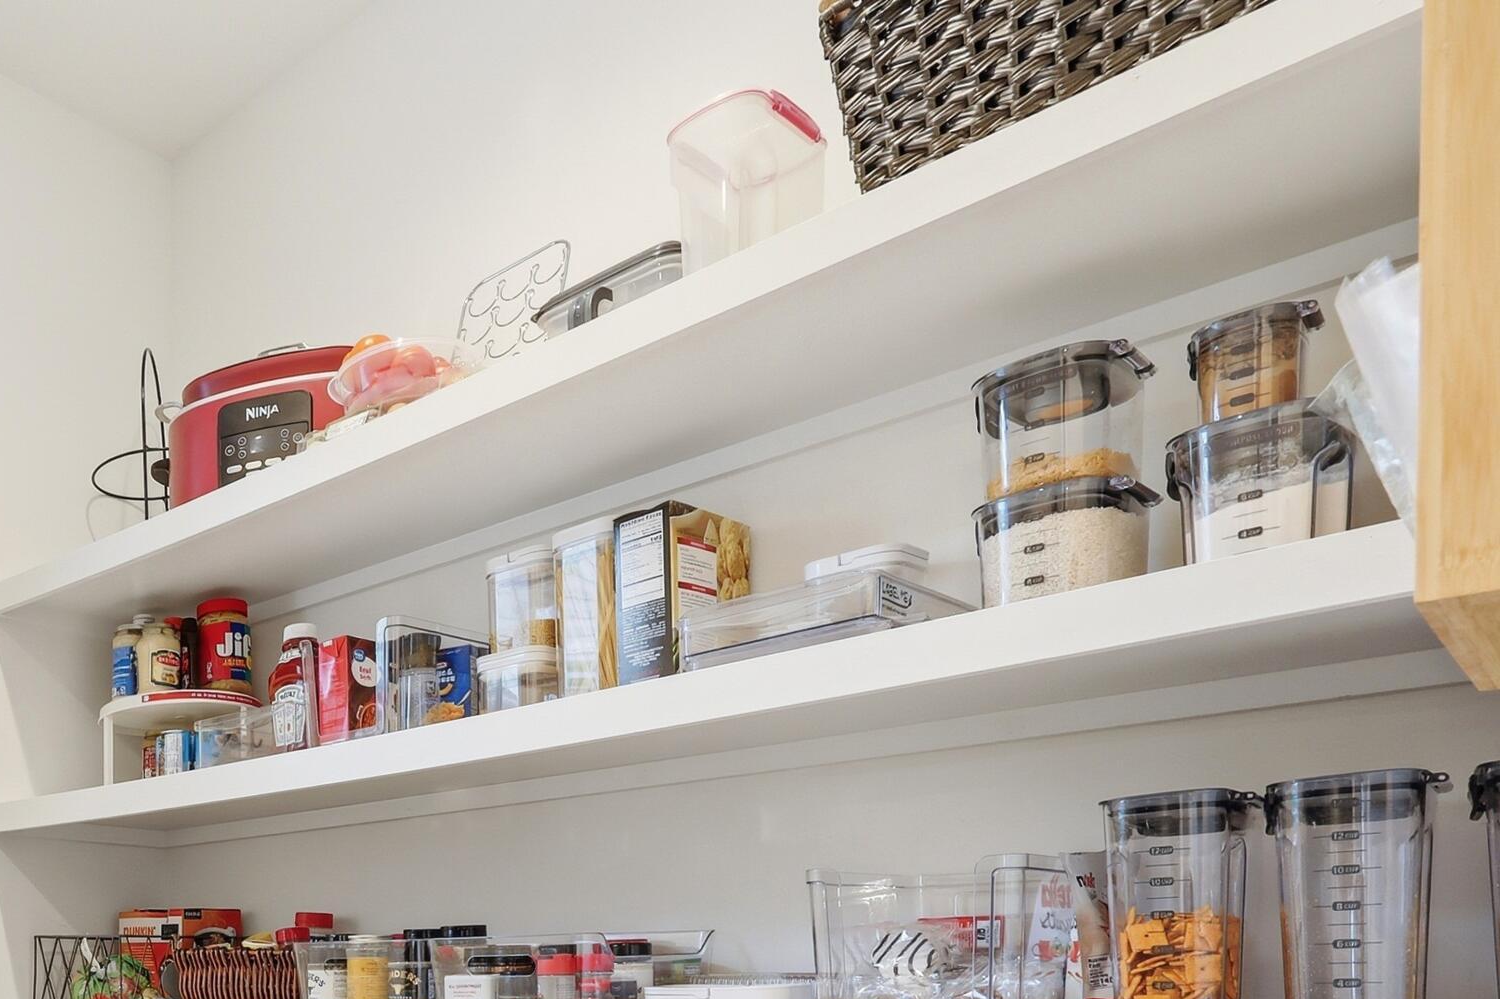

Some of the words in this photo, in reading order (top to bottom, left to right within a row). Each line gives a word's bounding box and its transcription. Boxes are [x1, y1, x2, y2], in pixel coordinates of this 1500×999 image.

[245, 403, 280, 422] NINJA
[215, 631, 252, 658] Jif
[122, 925, 156, 936] DUNKIN'
